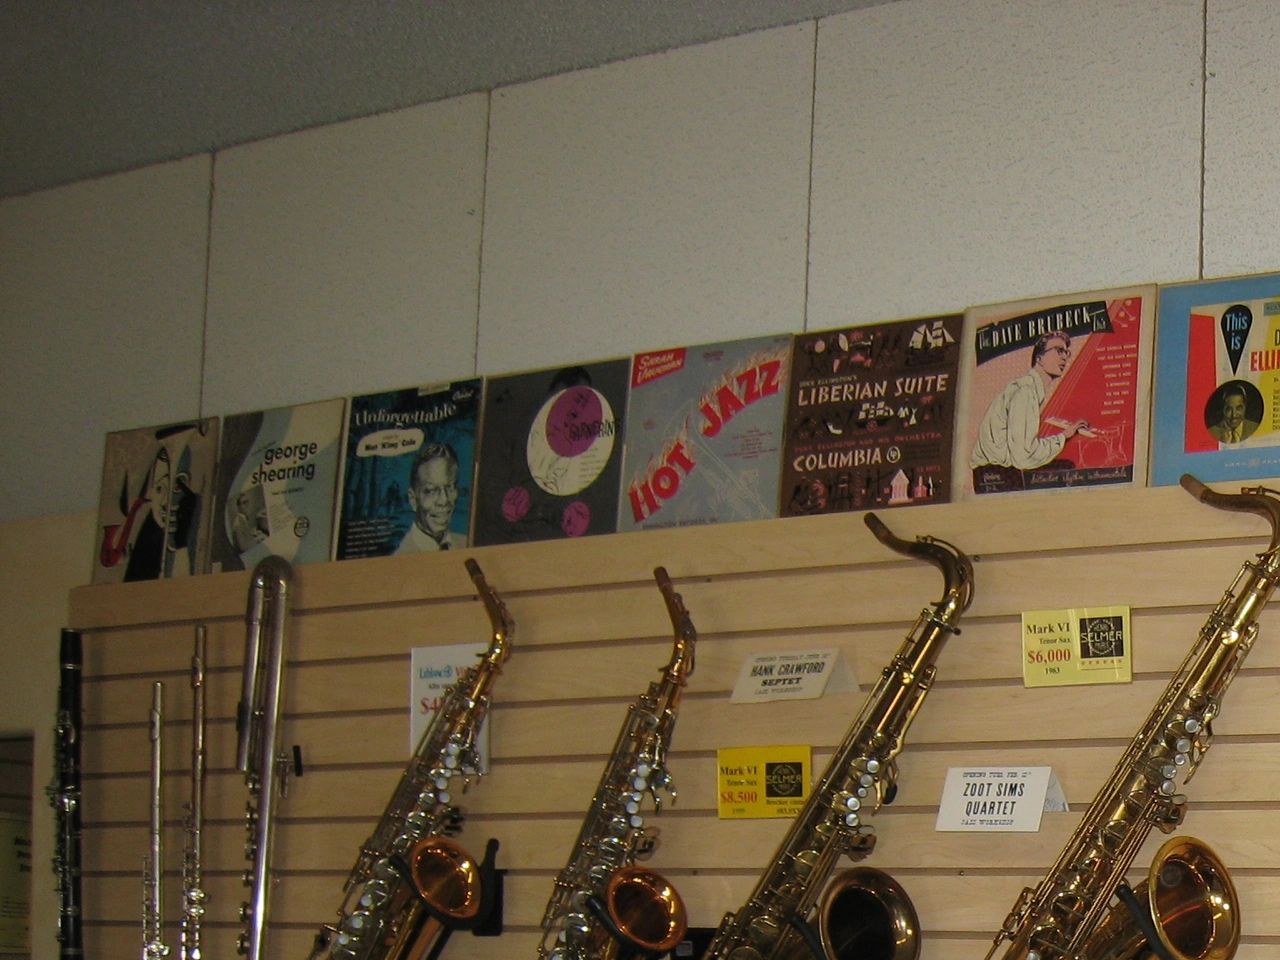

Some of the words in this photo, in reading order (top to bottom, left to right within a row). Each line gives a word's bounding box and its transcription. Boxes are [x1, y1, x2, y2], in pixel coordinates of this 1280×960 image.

[992, 322, 1022, 348] DAVE
[1028, 305, 1091, 338] BRUBECK
[1225, 312, 1249, 332] This
[1231, 332, 1241, 350] is
[699, 359, 782, 438] JAZZ
[797, 380, 888, 407] LIBERIAN
[894, 373, 950, 398] SUITE
[355, 402, 457, 427] Unforgettable
[264, 442, 318, 464] george
[792, 447, 882, 472] COLUMBIA
[251, 460, 315, 485] shearing
[629, 441, 697, 523] HOT
[1027, 623, 1055, 635] Mark
[1057, 622, 1070, 633] VI
[1080, 630, 1123, 644] SELMER
[1027, 648, 1071, 664] $6,000
[778, 662, 825, 676] CRAWFORD
[761, 677, 802, 687] SEPTET
[720, 766, 744, 776] Mark
[746, 765, 758, 775] VI
[766, 774, 802, 784] SELMER
[963, 783, 992, 796] ZOOT
[996, 783, 1025, 796] SIMS
[965, 801, 1016, 816] QUARTET
